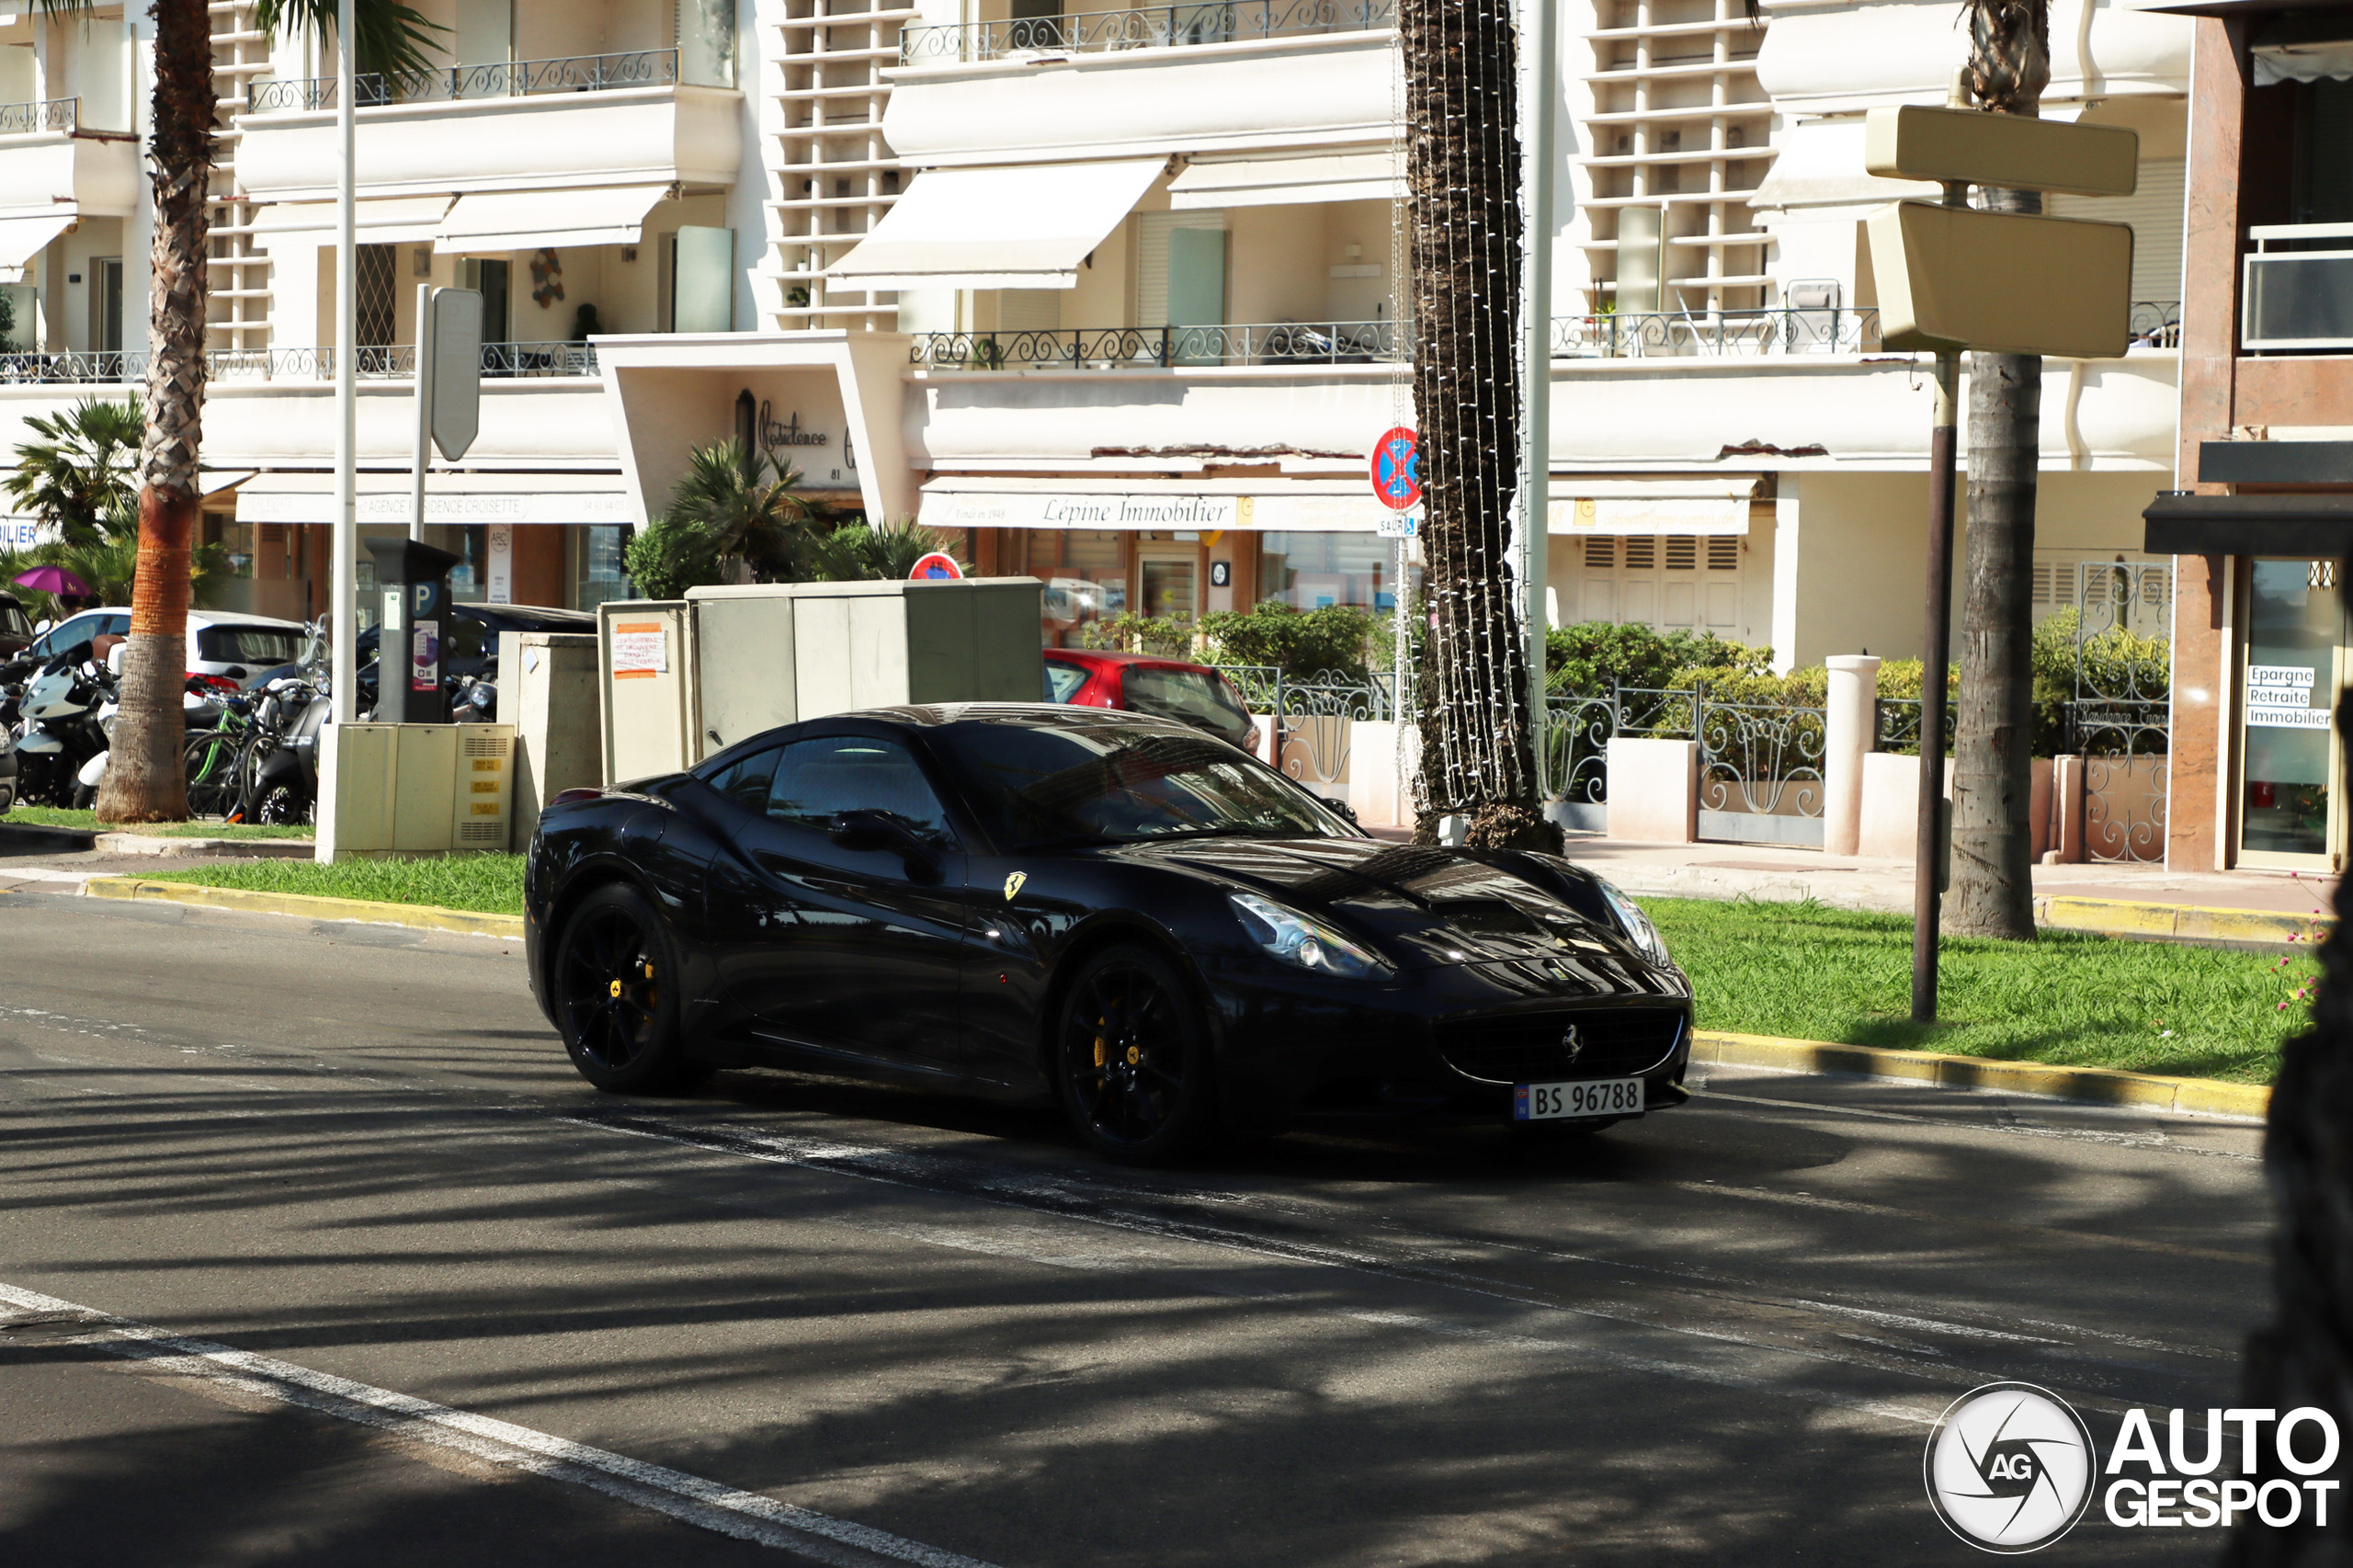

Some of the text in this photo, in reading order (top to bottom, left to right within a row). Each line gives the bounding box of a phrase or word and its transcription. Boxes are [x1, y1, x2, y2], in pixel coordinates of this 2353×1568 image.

[831, 470, 840, 480] 81
[369, 499, 405, 513] AGENCE
[465, 499, 519, 513] CROISETTE
[1043, 497, 1228, 526] Lépine Immobilier
[416, 585, 430, 611] P
[2252, 667, 2313, 687] Epargne
[2250, 689, 2308, 704] Retraite
[2250, 709, 2331, 724] Immobilier
[1536, 1082, 1638, 1115] BS 96788
[1518, 1106, 1526, 1115] N
